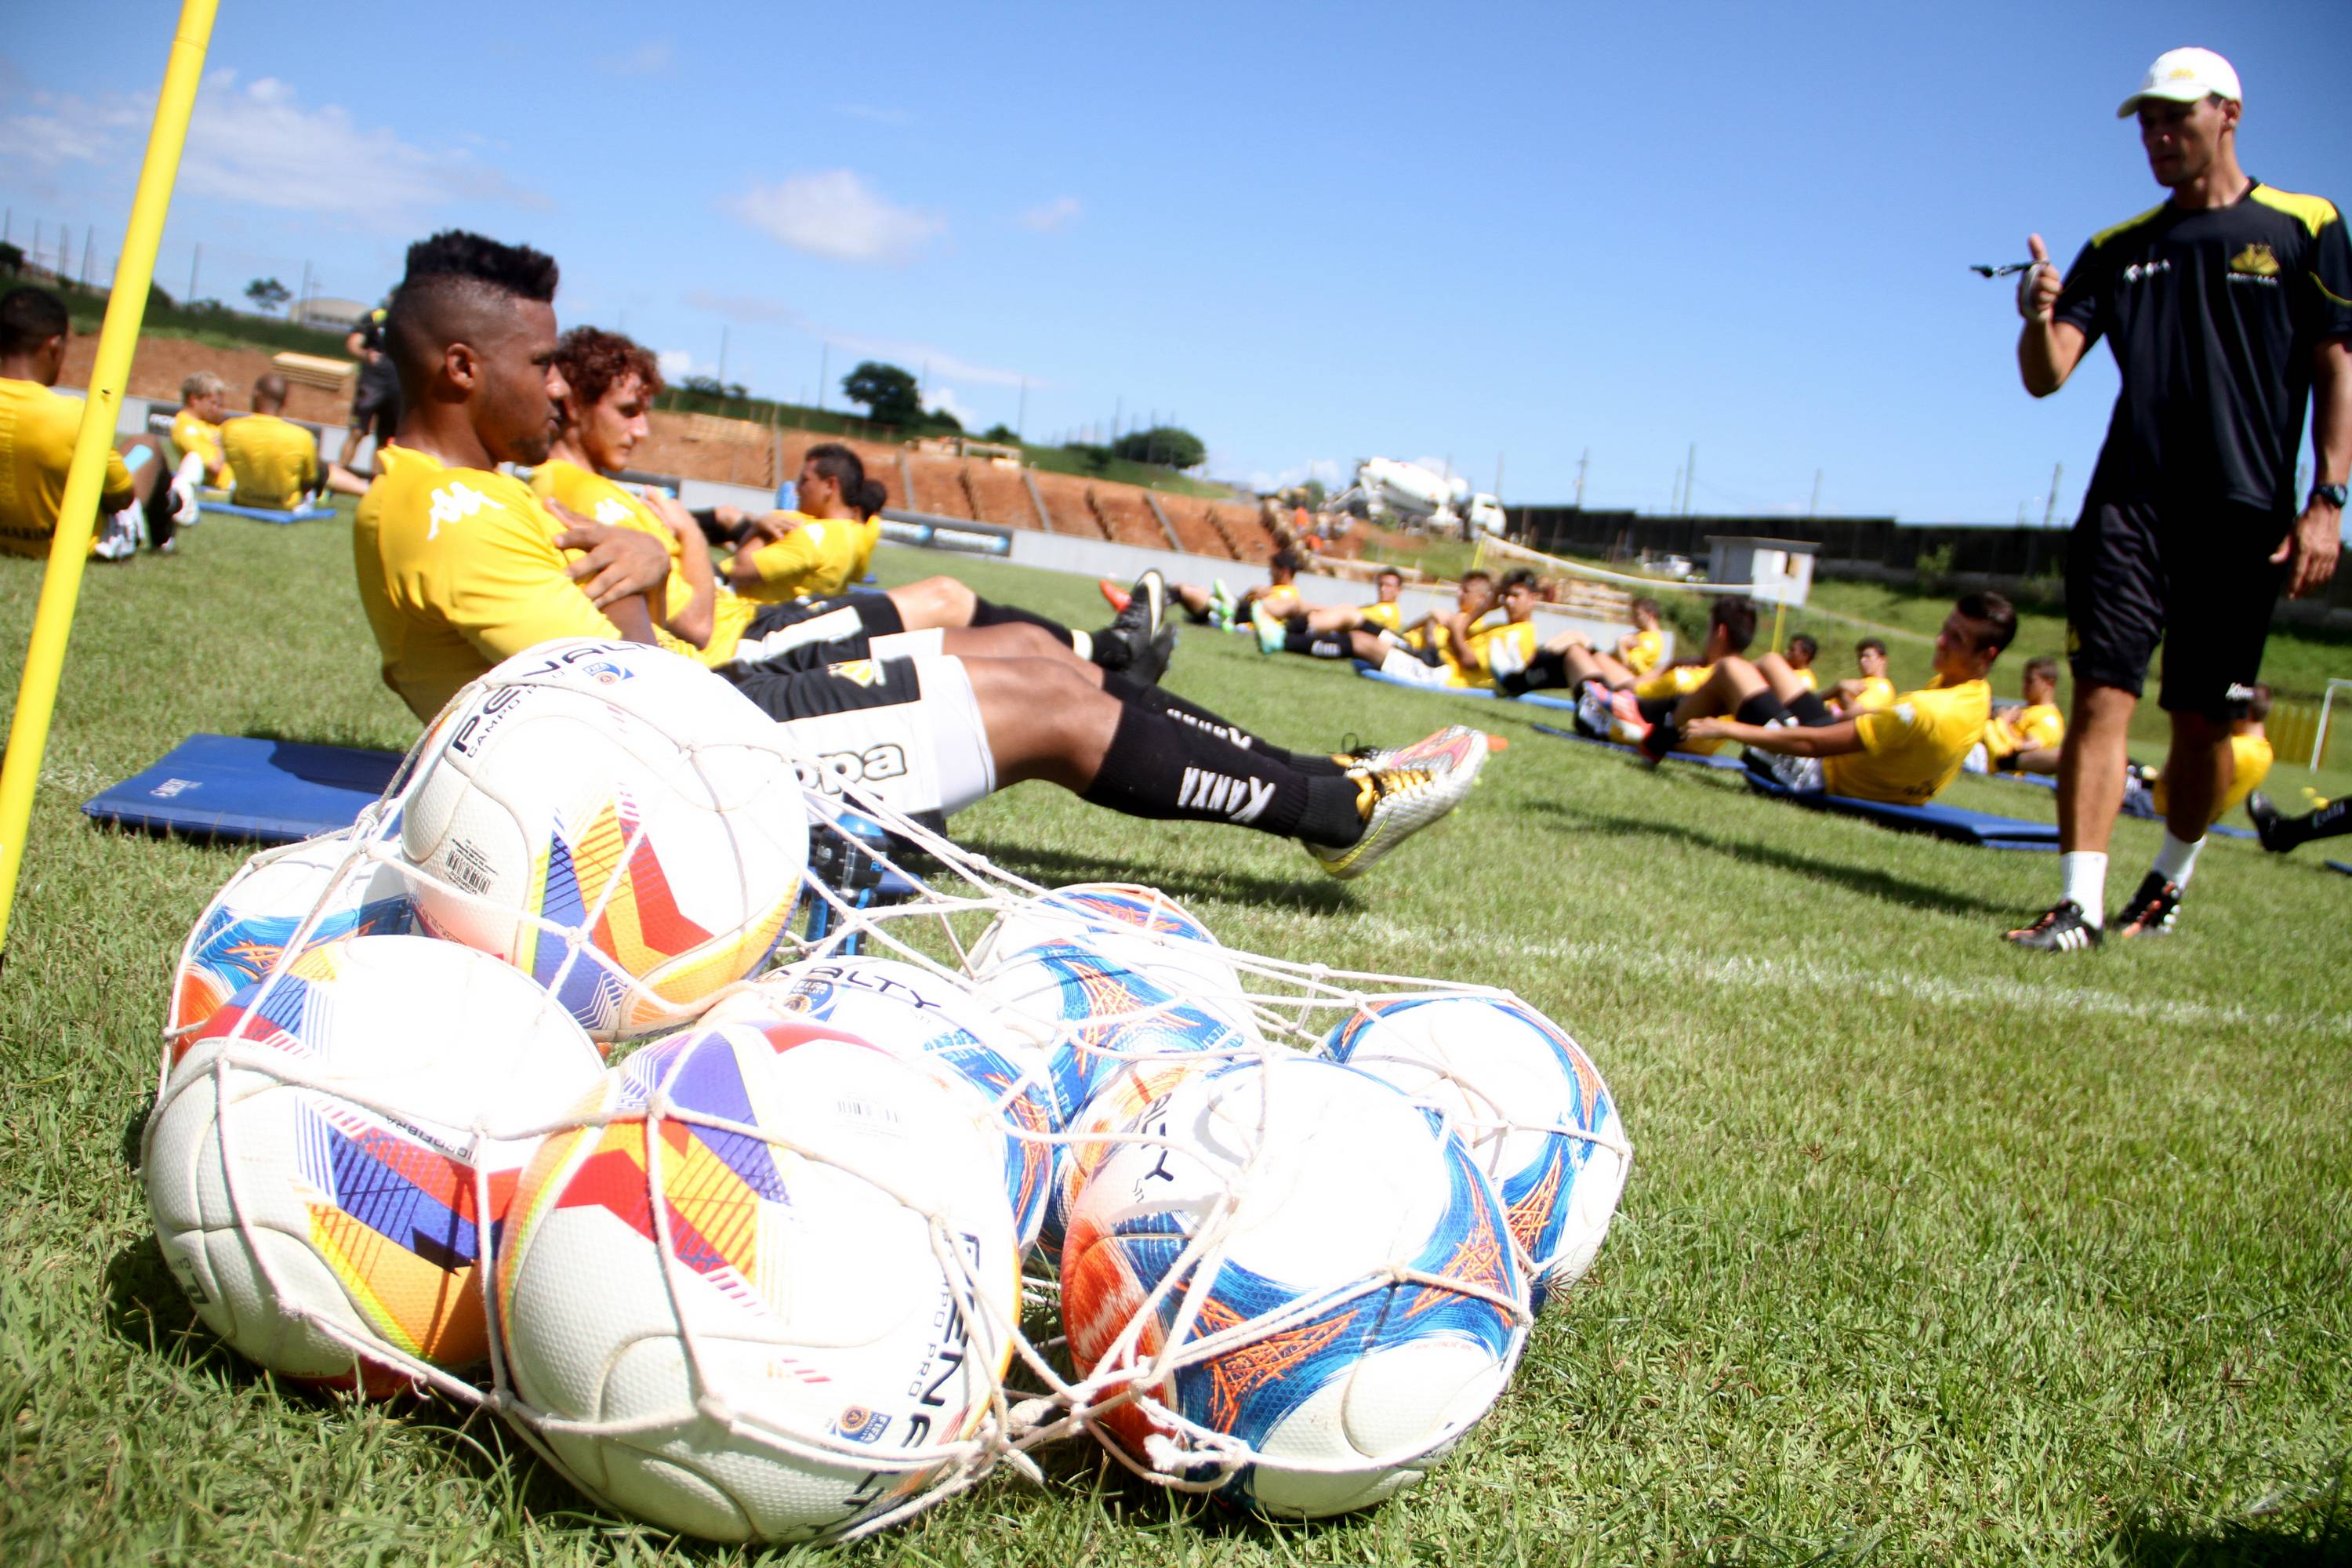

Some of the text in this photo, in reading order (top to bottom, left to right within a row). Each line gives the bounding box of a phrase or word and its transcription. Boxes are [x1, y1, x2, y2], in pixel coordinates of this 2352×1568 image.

[466, 699, 521, 758] CAMPO
[1176, 765, 1277, 823] KANXA
[387, 1115, 476, 1163] ICROFIBRA
[908, 1343, 937, 1397] PRO
